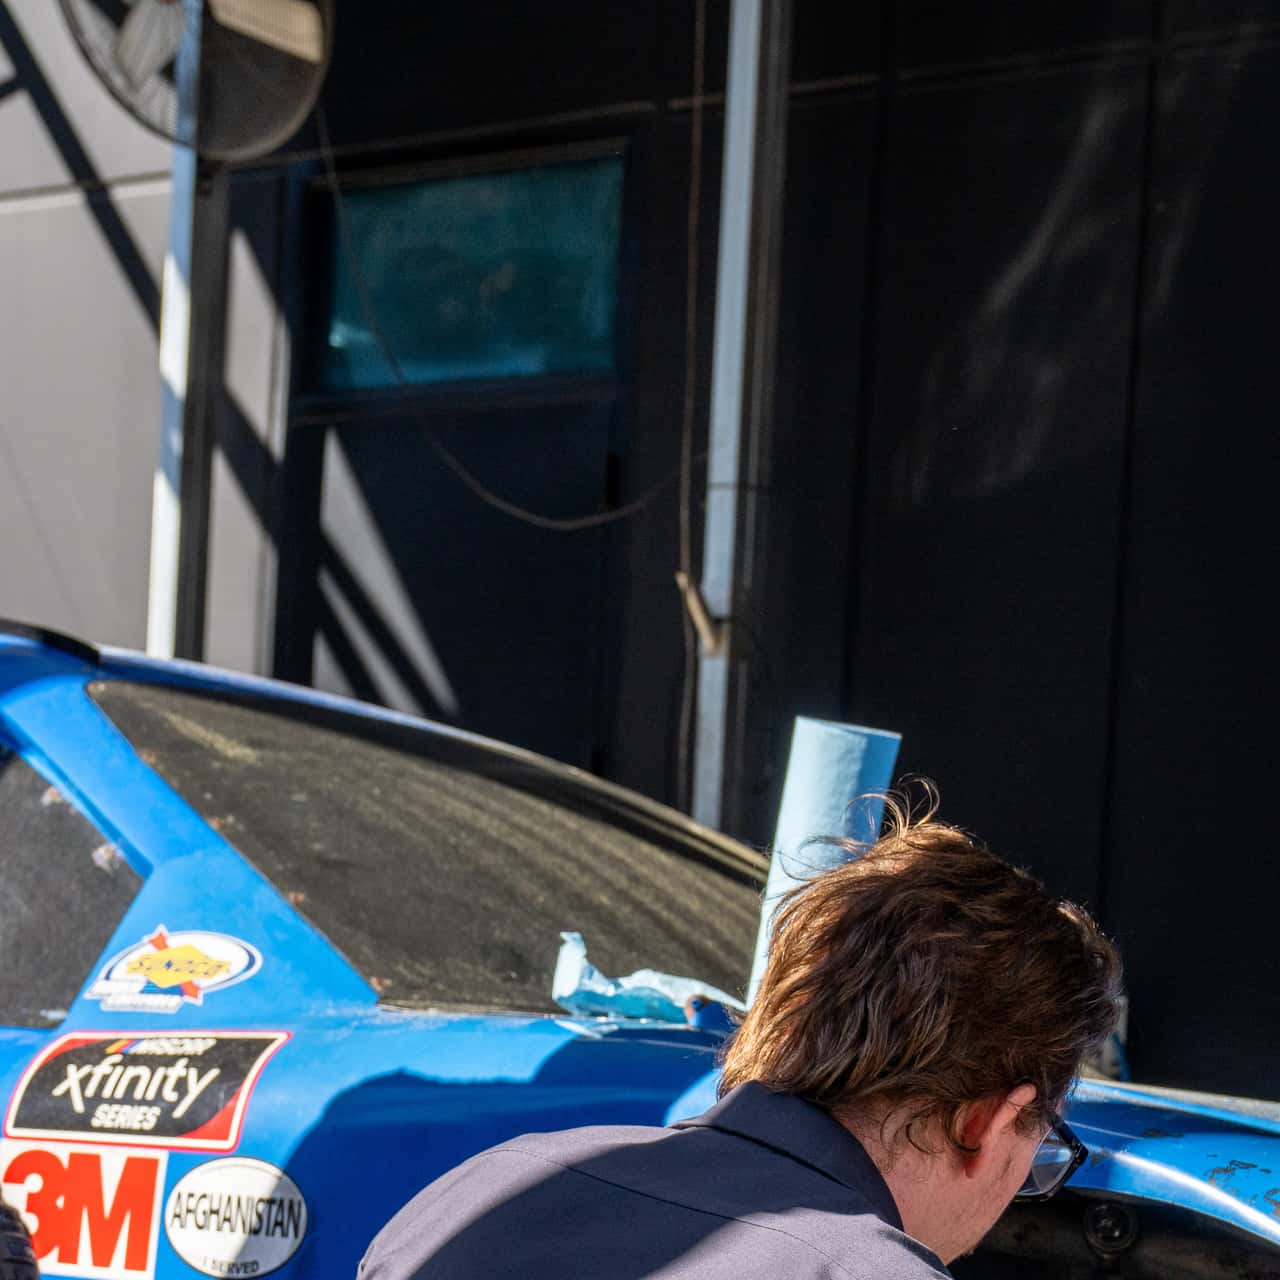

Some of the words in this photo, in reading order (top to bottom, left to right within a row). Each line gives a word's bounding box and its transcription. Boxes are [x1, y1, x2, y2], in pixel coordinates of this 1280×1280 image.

[51, 1054, 221, 1119] xfinity
[91, 1103, 161, 1130] SERIES
[3, 1148, 160, 1273] 3M
[171, 1191, 303, 1239] AFGHANISTAN
